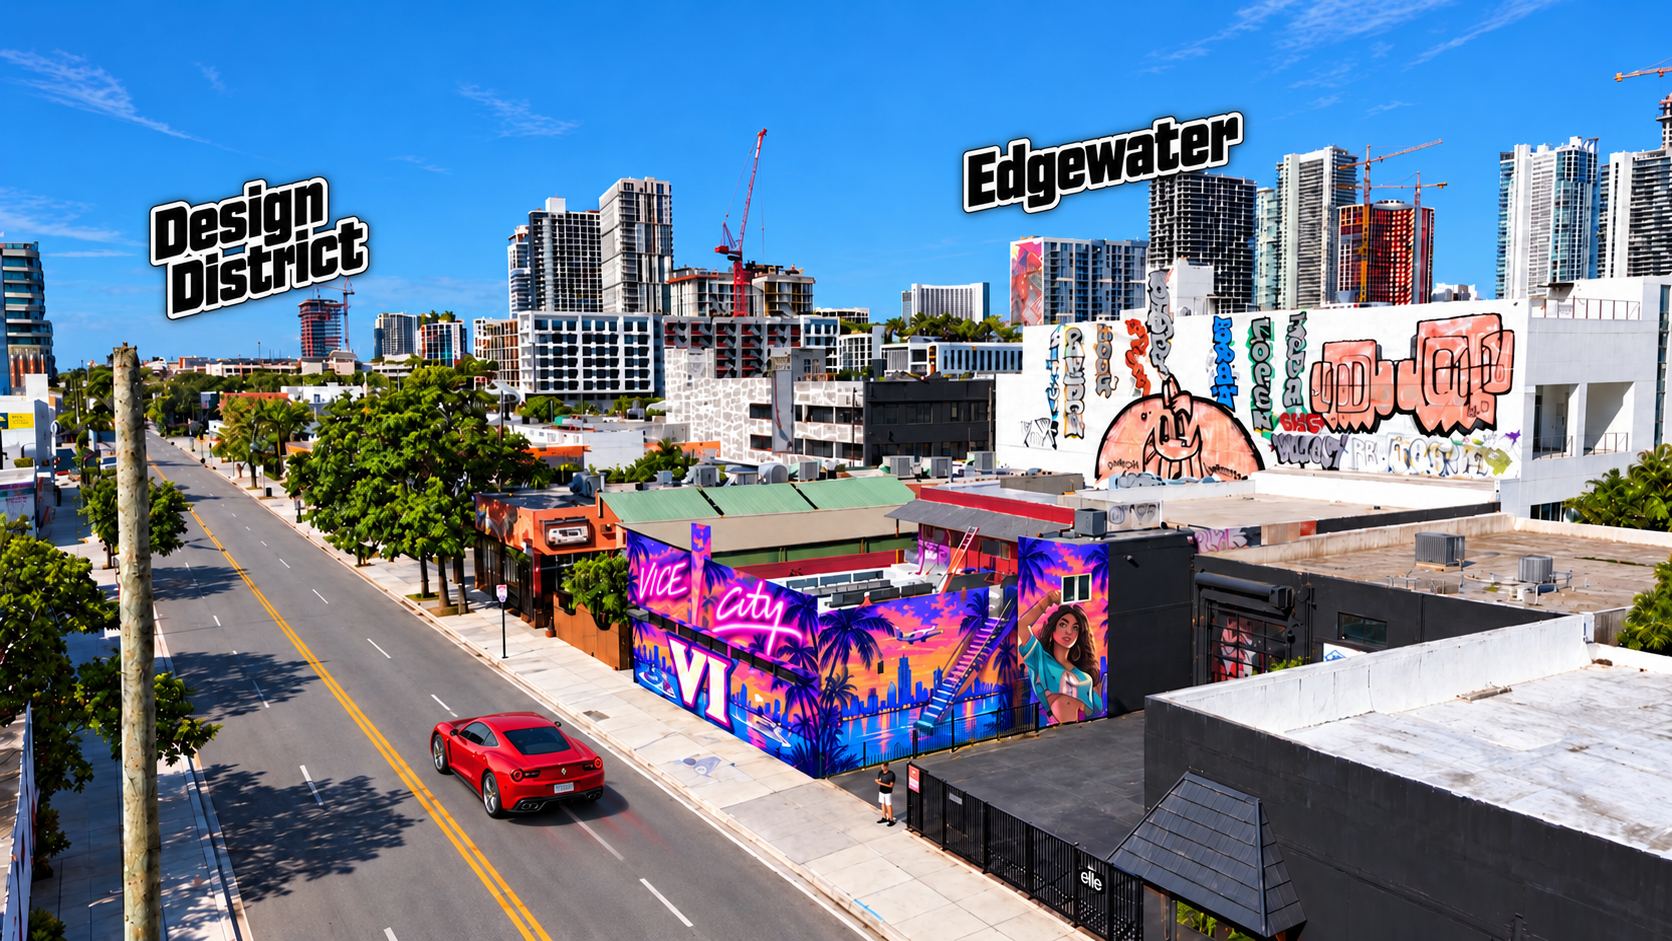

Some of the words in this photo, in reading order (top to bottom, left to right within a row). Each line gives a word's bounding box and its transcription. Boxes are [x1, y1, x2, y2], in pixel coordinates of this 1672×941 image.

[638, 562, 688, 601] VICE
[667, 634, 733, 731] VI
[1080, 870, 1103, 892] elle
